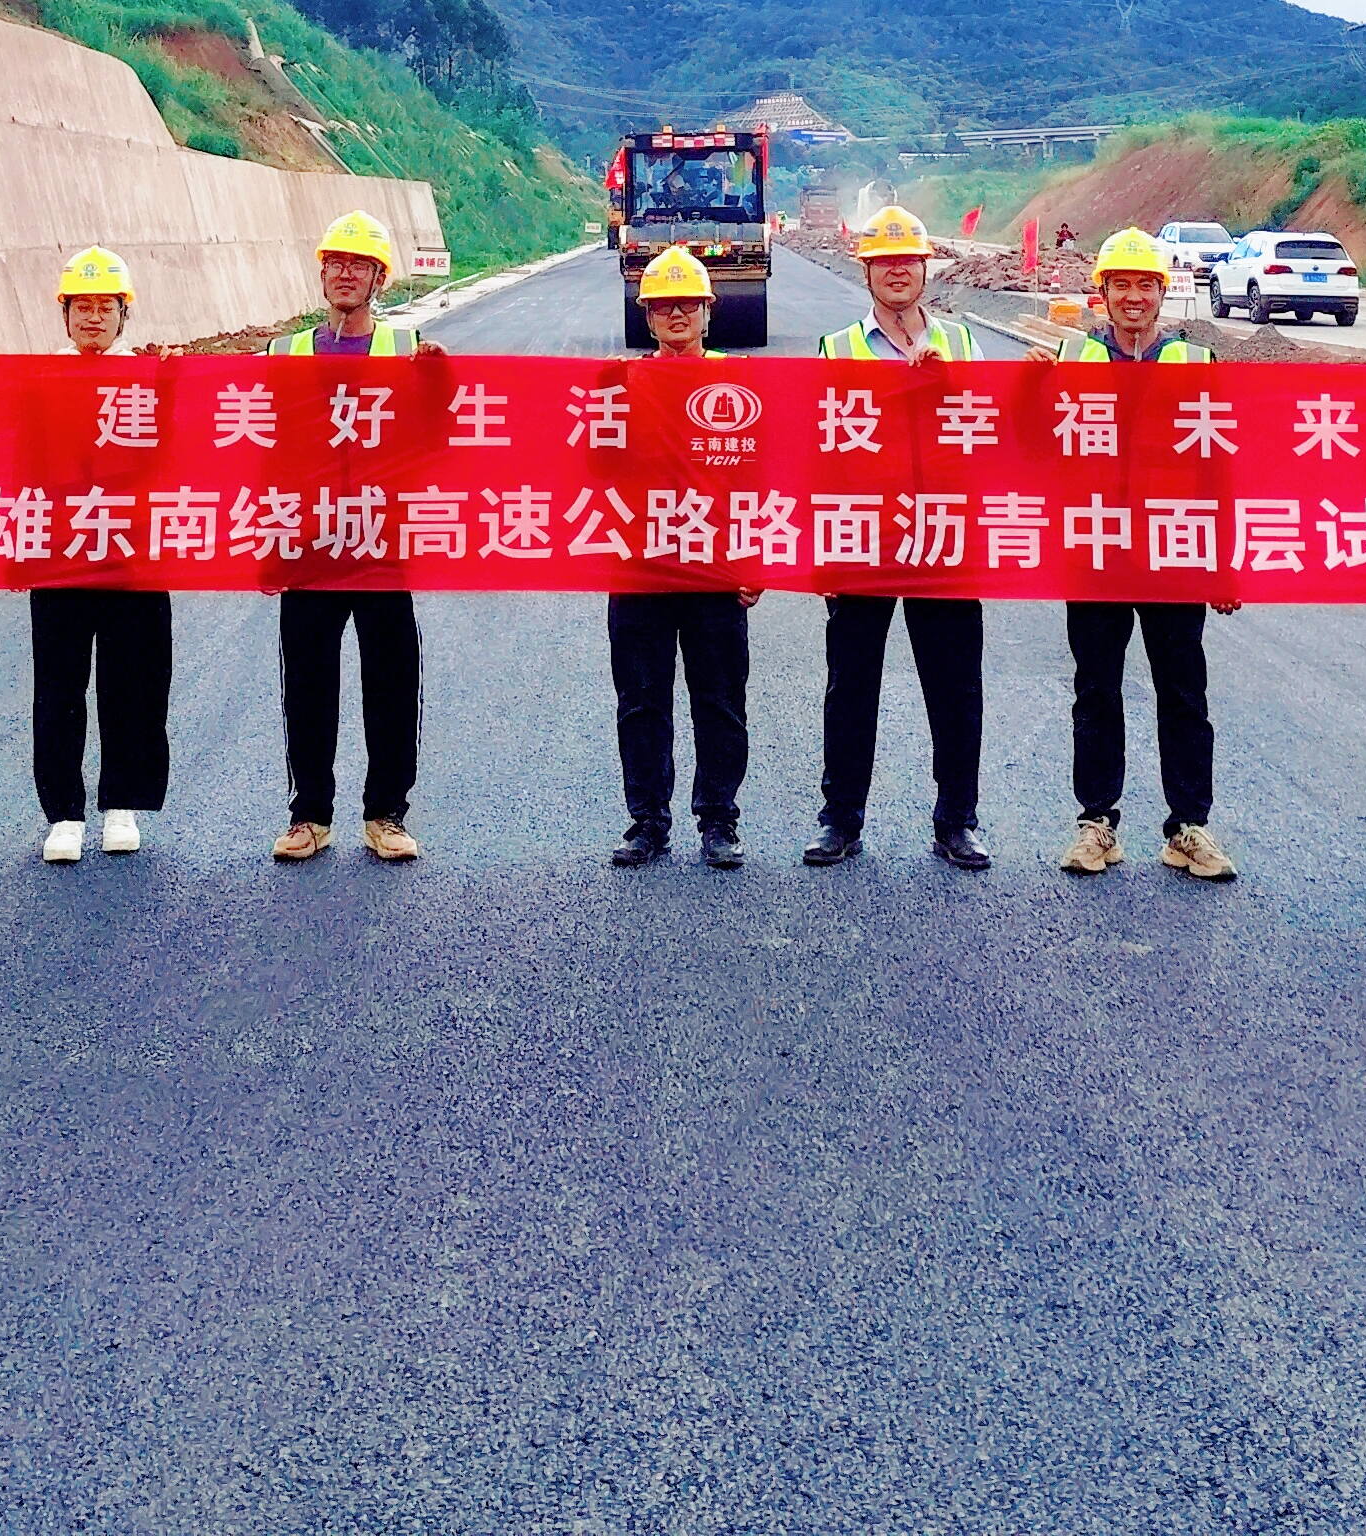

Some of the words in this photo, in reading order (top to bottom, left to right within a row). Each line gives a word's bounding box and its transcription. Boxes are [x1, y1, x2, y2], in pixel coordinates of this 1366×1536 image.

[94, 382, 630, 449] 建美好生活
[817, 386, 1361, 460] 投幸福未来
[690, 436, 757, 453] 云南建投
[705, 454, 742, 466] YCIH
